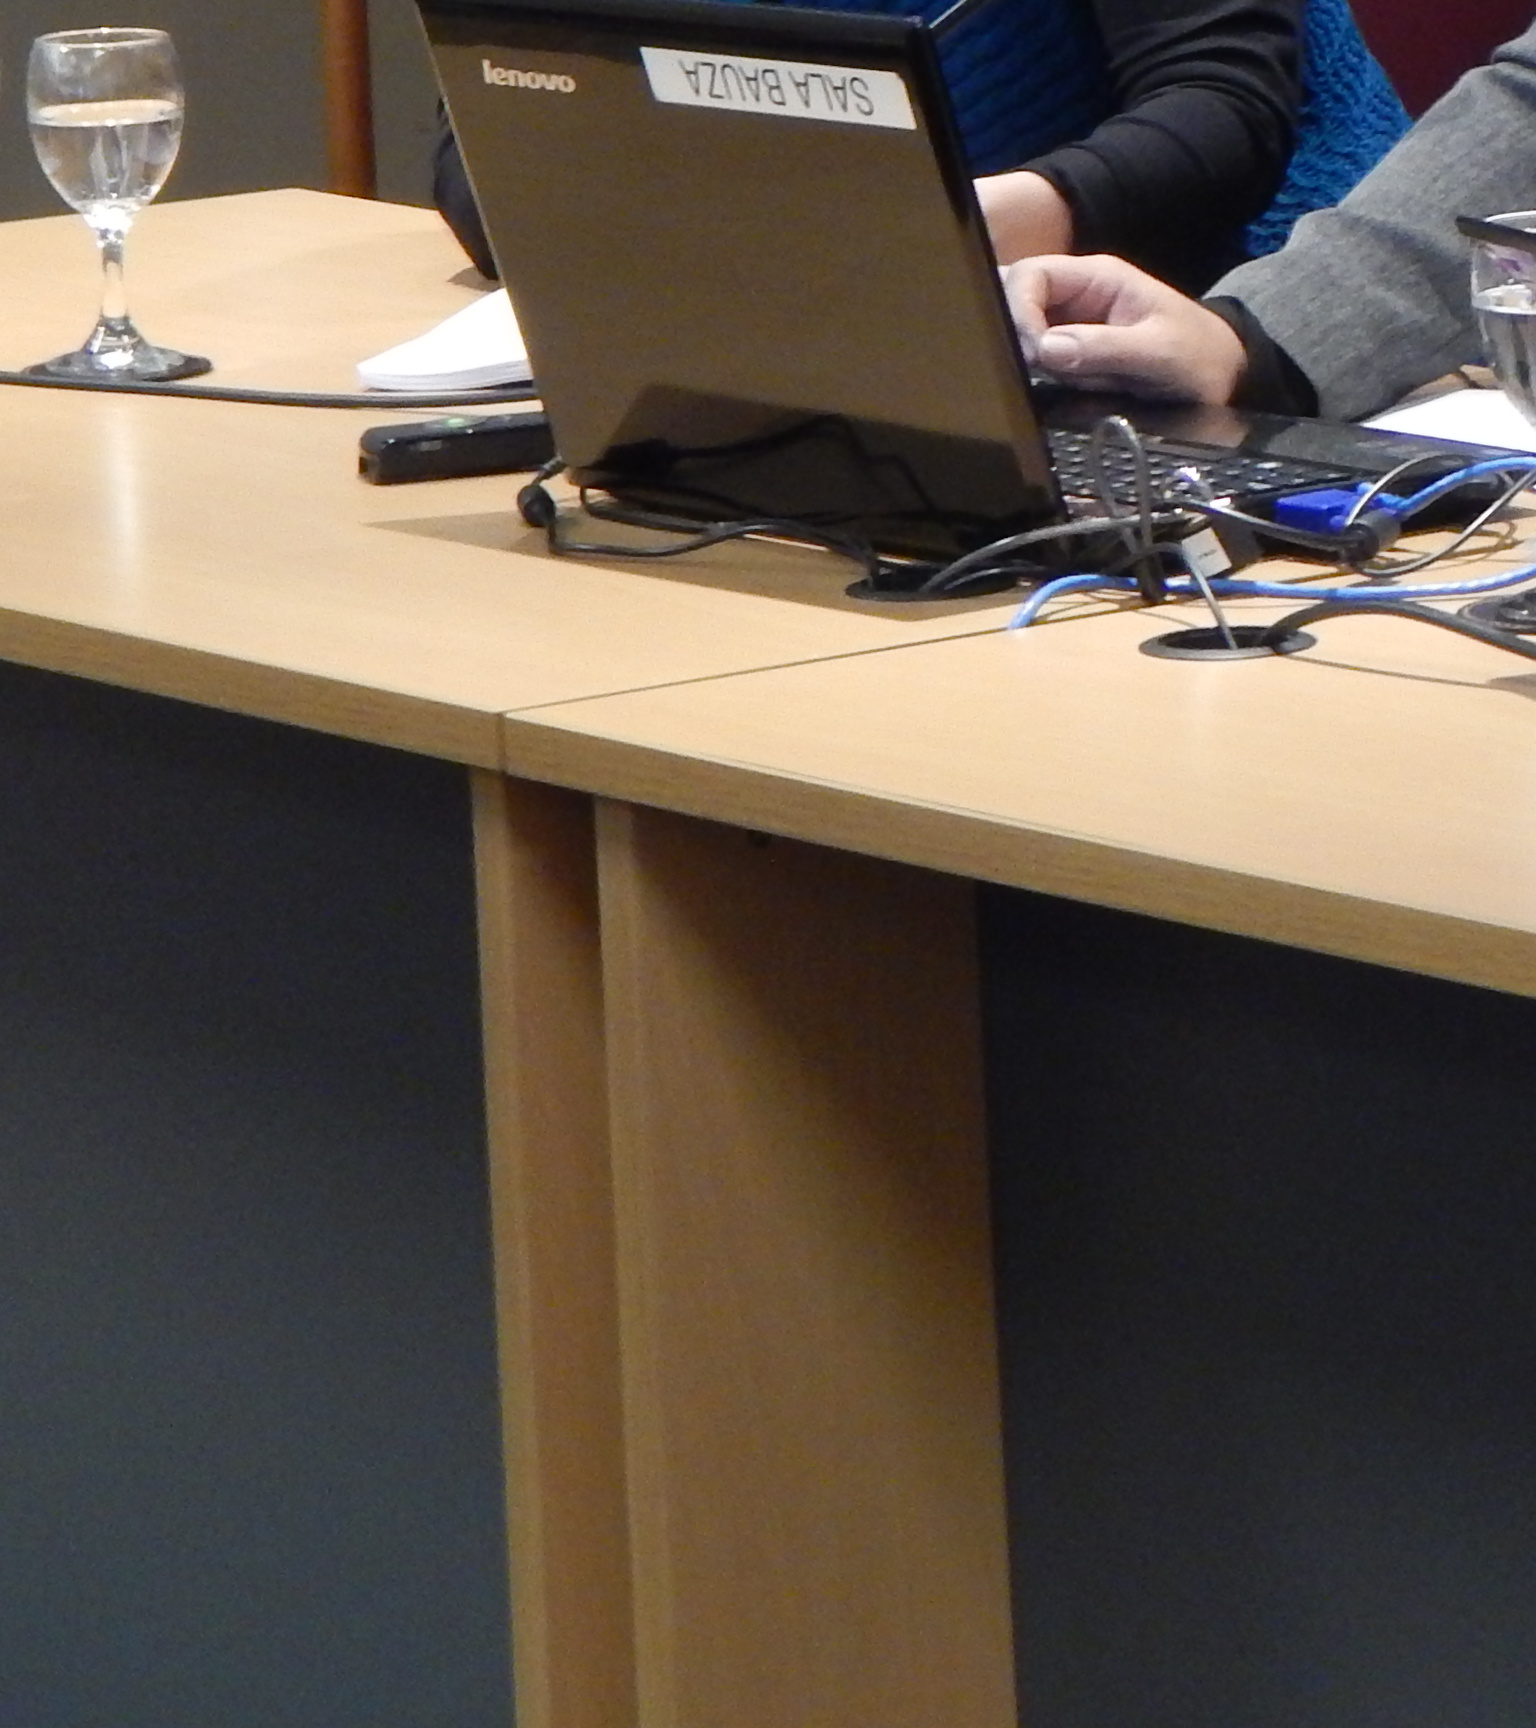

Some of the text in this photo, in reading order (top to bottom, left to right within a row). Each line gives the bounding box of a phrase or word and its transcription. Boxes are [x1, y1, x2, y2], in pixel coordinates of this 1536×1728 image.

[481, 59, 577, 94] lenovo
[678, 59, 875, 118] SALA BAUZA
